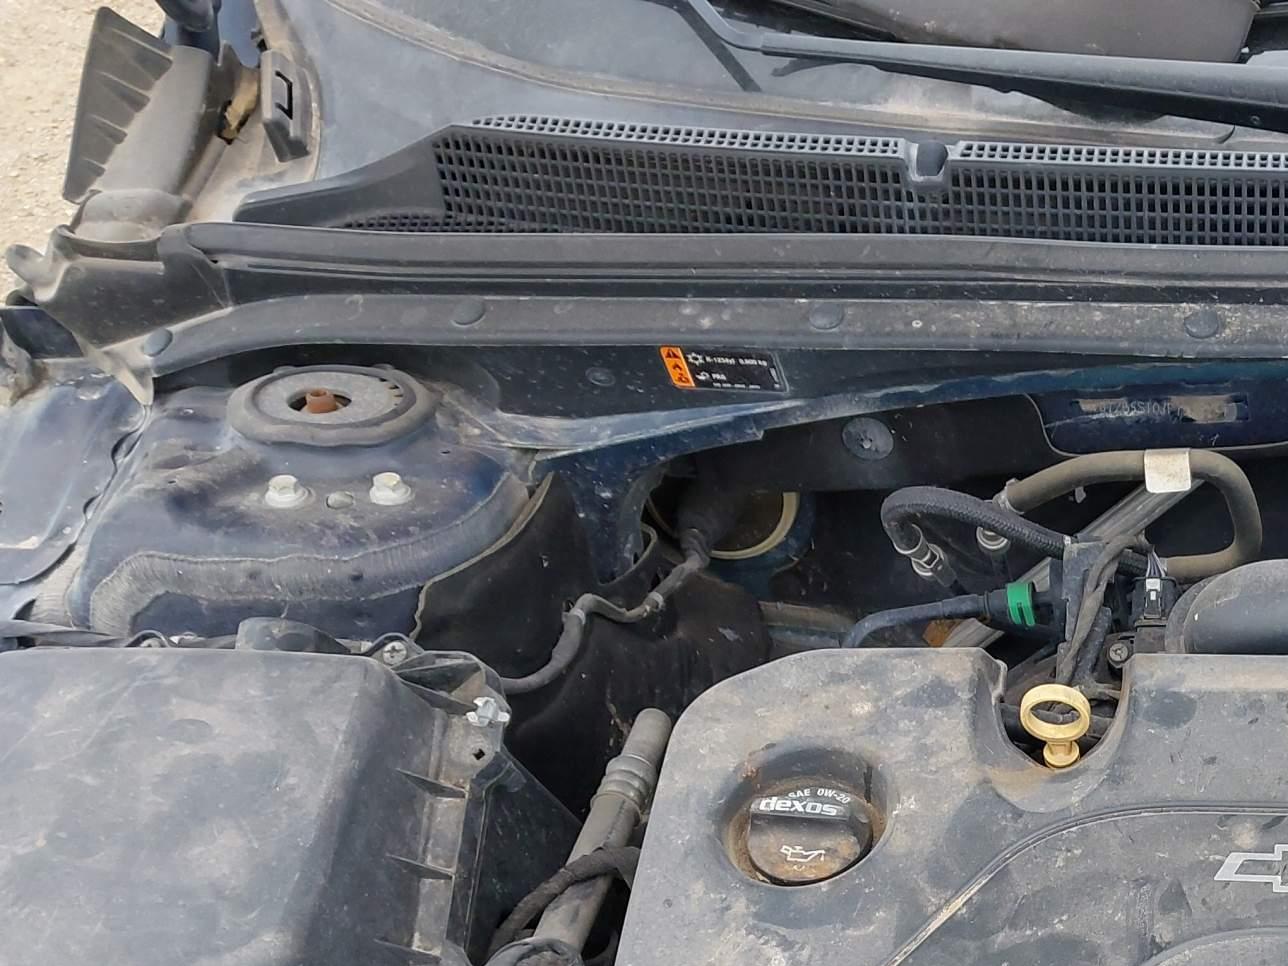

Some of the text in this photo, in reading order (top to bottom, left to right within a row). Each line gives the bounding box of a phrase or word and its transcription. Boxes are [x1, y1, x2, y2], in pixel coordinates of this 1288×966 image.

[788, 788, 852, 804] SAE 0W-20
[760, 796, 838, 816] dexos
